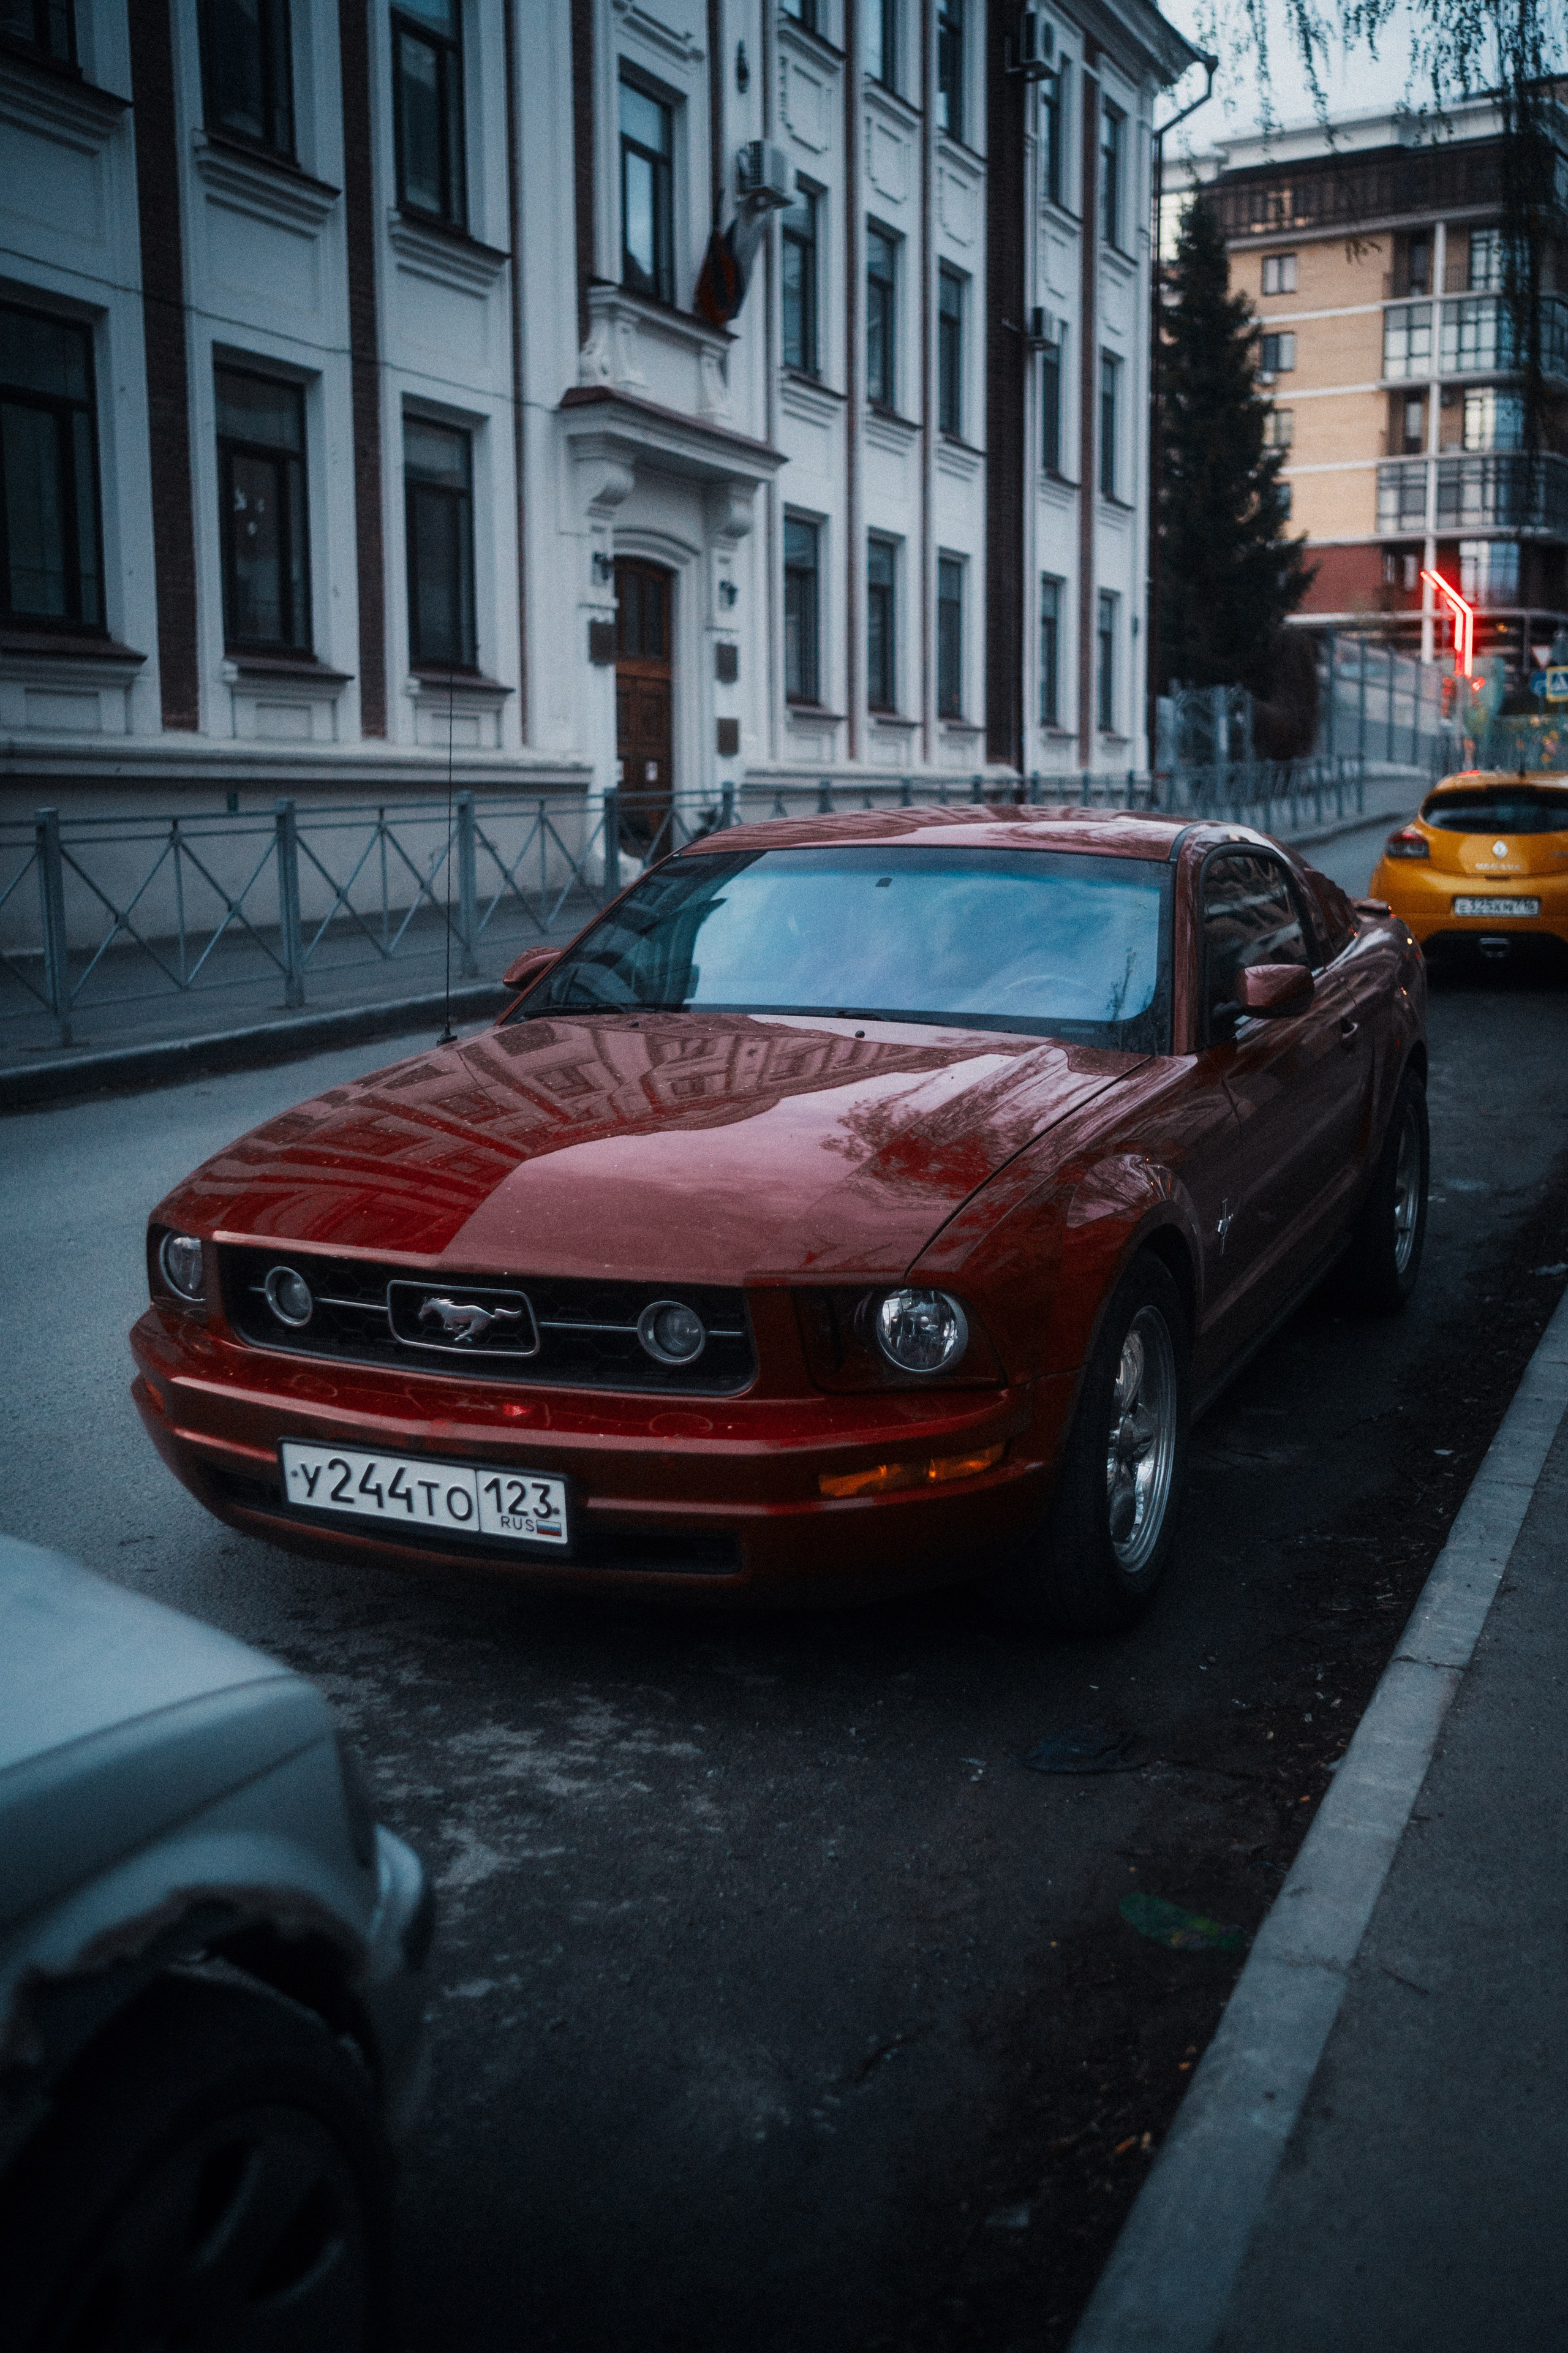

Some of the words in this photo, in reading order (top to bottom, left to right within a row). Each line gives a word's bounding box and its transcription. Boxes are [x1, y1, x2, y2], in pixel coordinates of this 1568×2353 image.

[300, 1457, 473, 1521] У244ТО
[483, 1477, 552, 1519] 123
[500, 1516, 535, 1532] RUS
